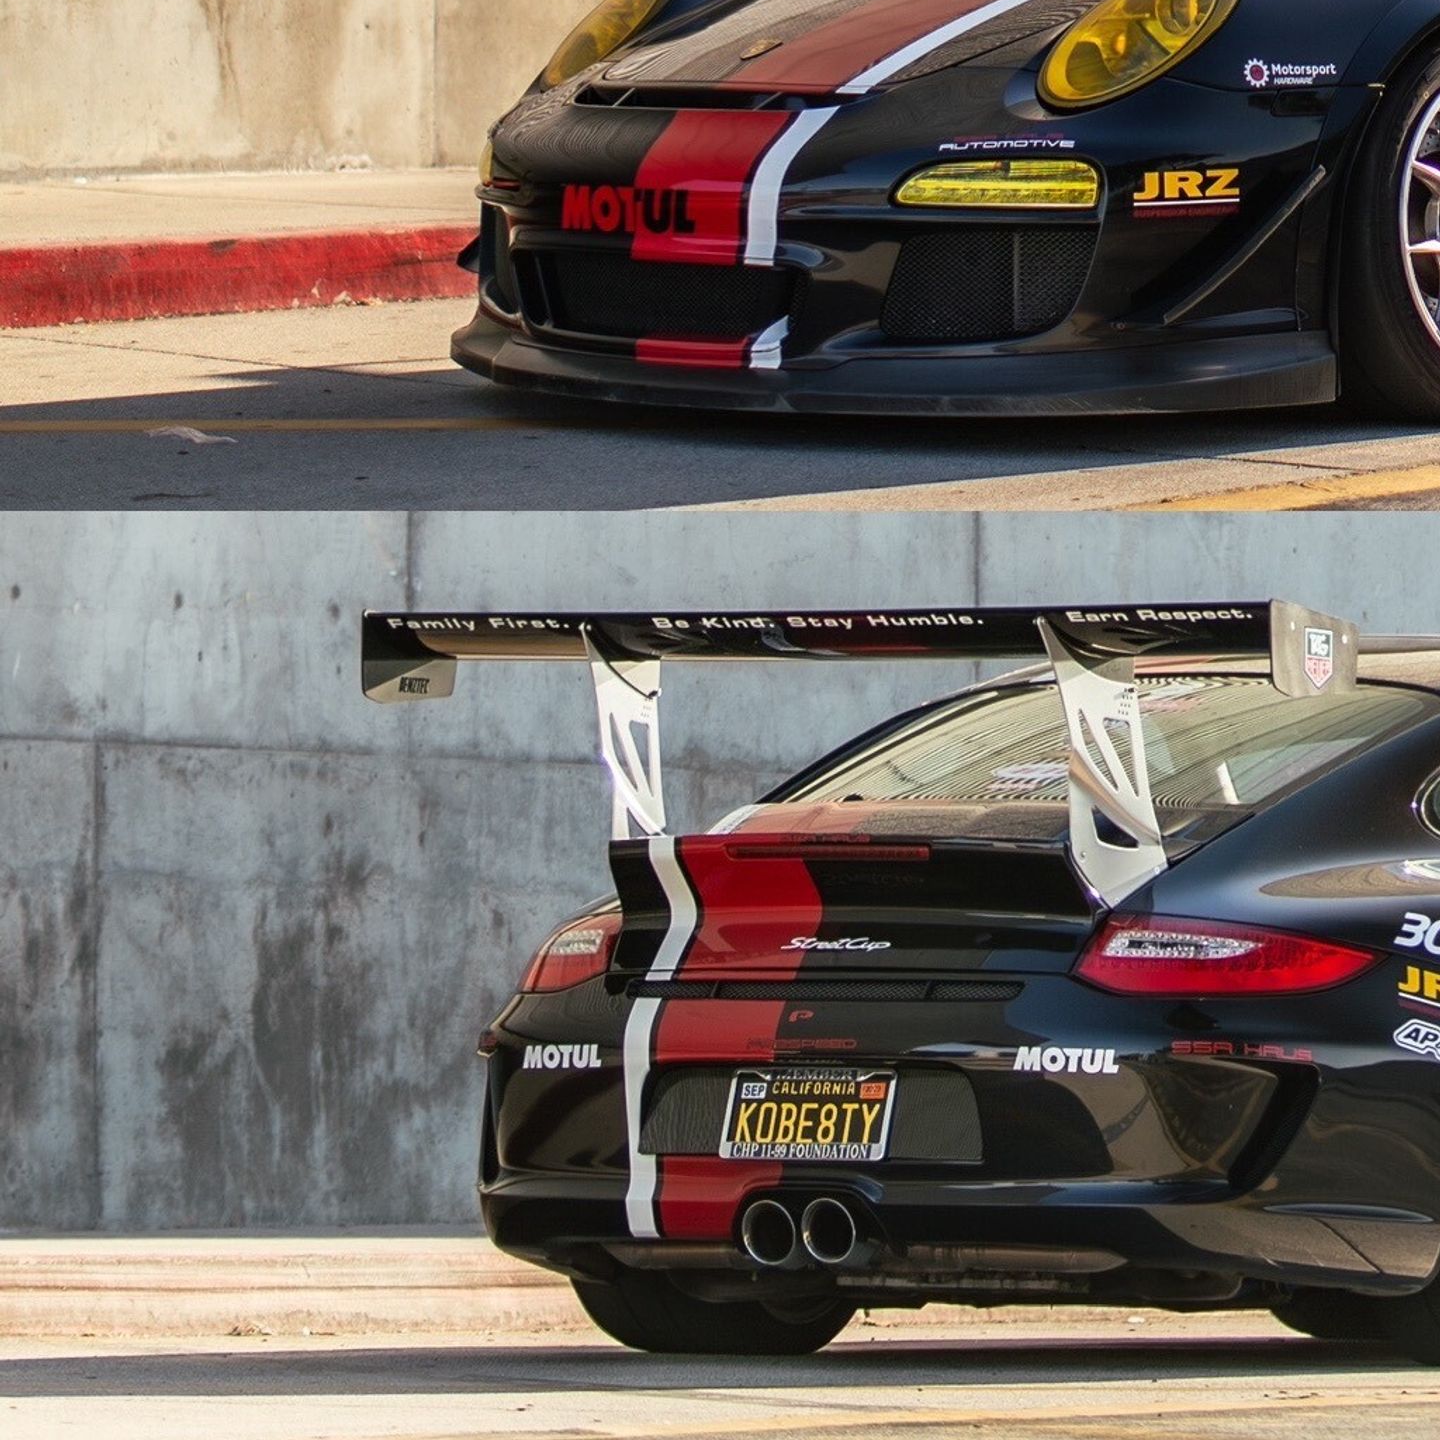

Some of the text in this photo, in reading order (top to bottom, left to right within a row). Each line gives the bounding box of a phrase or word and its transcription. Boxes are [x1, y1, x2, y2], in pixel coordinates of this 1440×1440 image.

[1272, 63, 1337, 77] Motorsport
[939, 138, 1076, 152] AUTOMOTIVE
[1133, 169, 1240, 201] JRZ
[562, 183, 696, 234] MOTUL
[386, 607, 1254, 632] Family First. Be Kind. Stay Humble. Earn Respect.
[522, 1044, 602, 1069] MOTUL
[1013, 1046, 1120, 1074] MOTUL
[1171, 1040, 1312, 1061] SSA HAUS
[743, 1084, 765, 1097] SEP
[772, 1081, 856, 1095] CALIFORNIA
[735, 1102, 881, 1144] KOBE8TY
[732, 1144, 761, 1158] CHP
[788, 1144, 869, 1158] FOUNDATION
